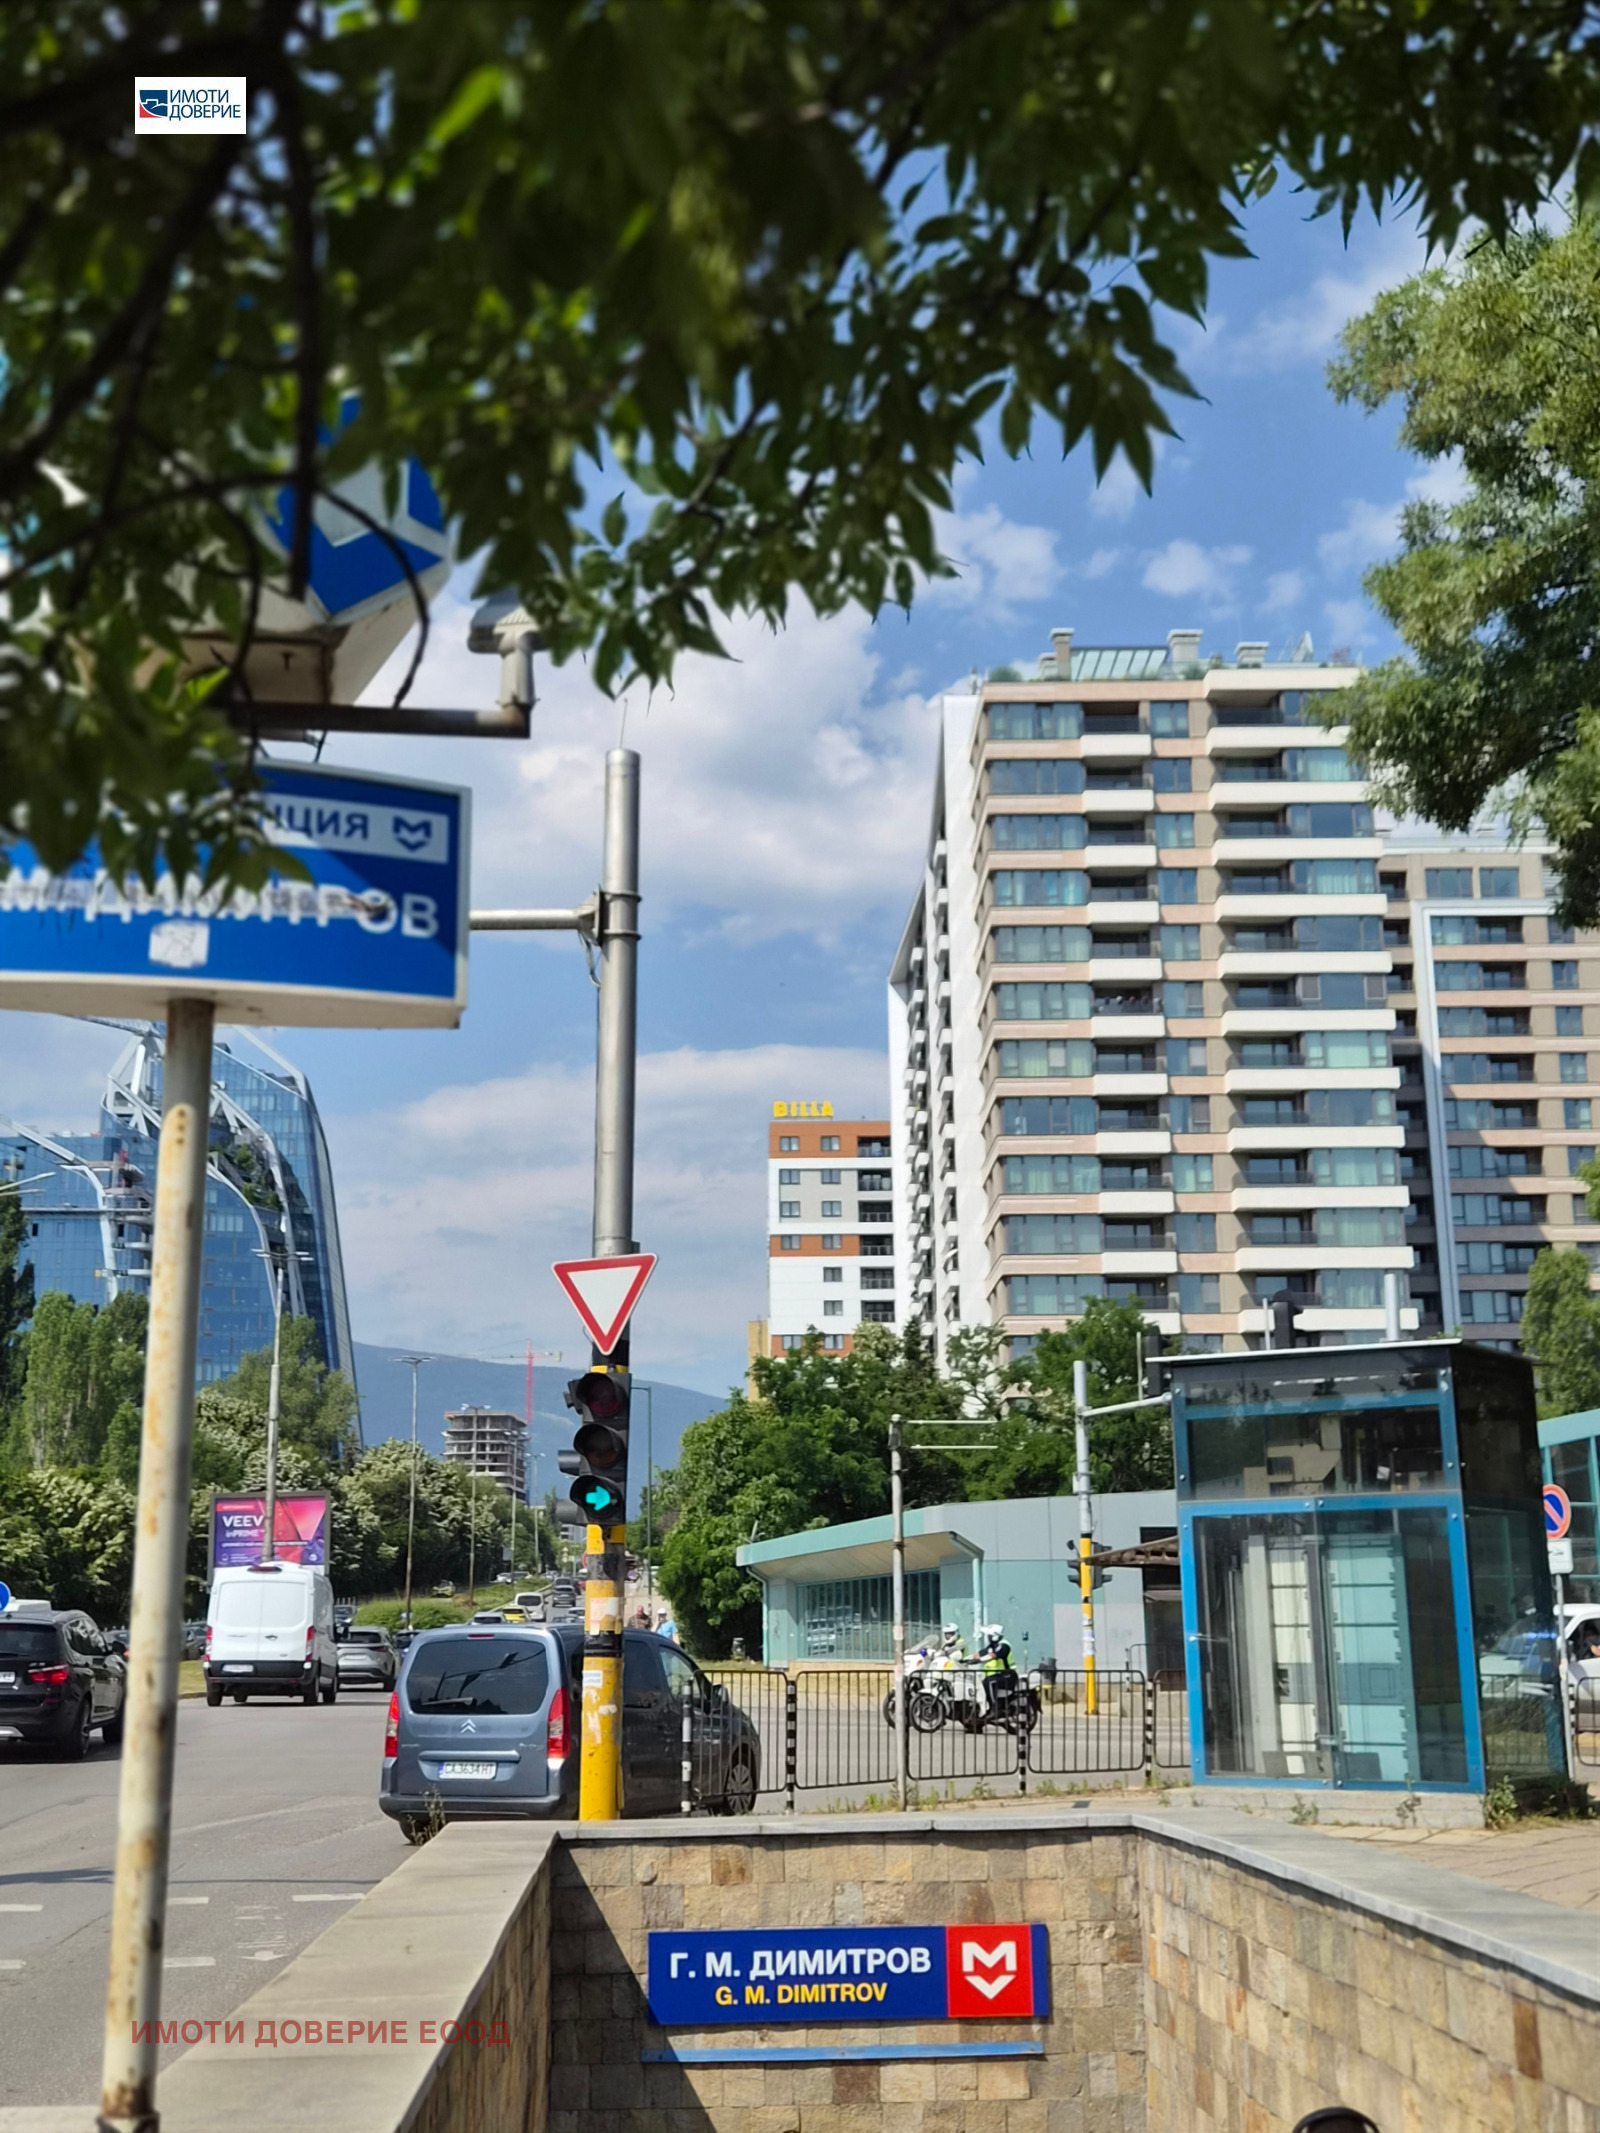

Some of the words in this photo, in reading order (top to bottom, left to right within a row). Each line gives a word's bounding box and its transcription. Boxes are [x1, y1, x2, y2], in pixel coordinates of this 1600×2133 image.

[773, 1101, 833, 1118] BILLA
[222, 1515, 264, 1528] VEEV
[670, 1952, 696, 1978] Г.
[705, 1951, 740, 1977] М.
[749, 1947, 931, 1981] ДИМИТРОВ
[715, 1986, 738, 2006] G.
[745, 1985, 770, 2005] M.
[777, 1982, 887, 2004] DIMITROV
